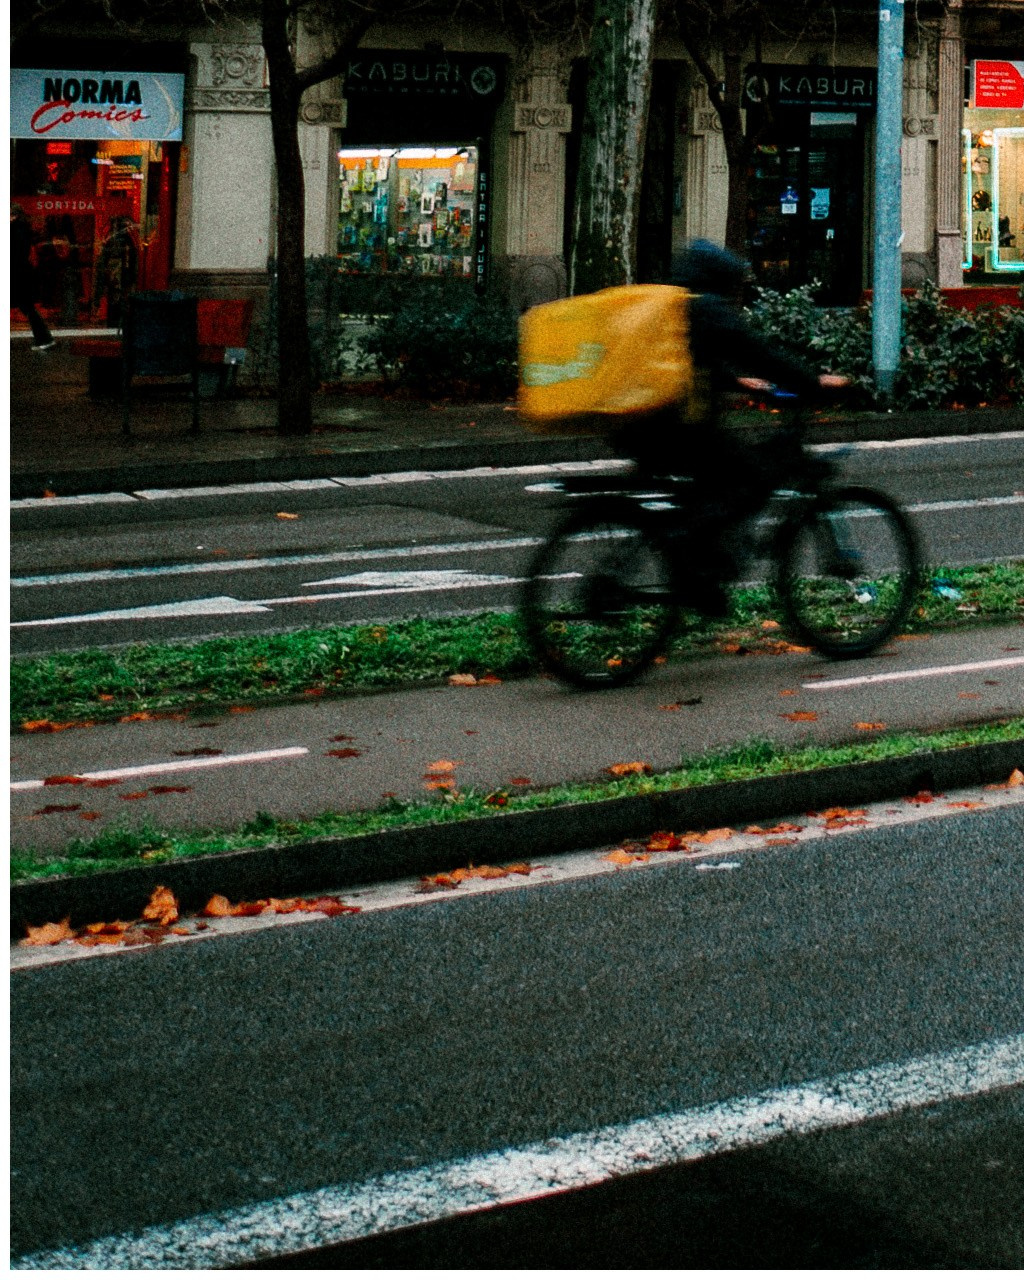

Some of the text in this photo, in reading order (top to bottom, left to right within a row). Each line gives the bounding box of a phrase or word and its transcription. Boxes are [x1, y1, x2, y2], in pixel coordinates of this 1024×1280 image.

[348, 62, 459, 82] KABURI
[43, 77, 142, 104] NORMA
[779, 75, 873, 96] KABURI
[31, 99, 151, 134] Comics
